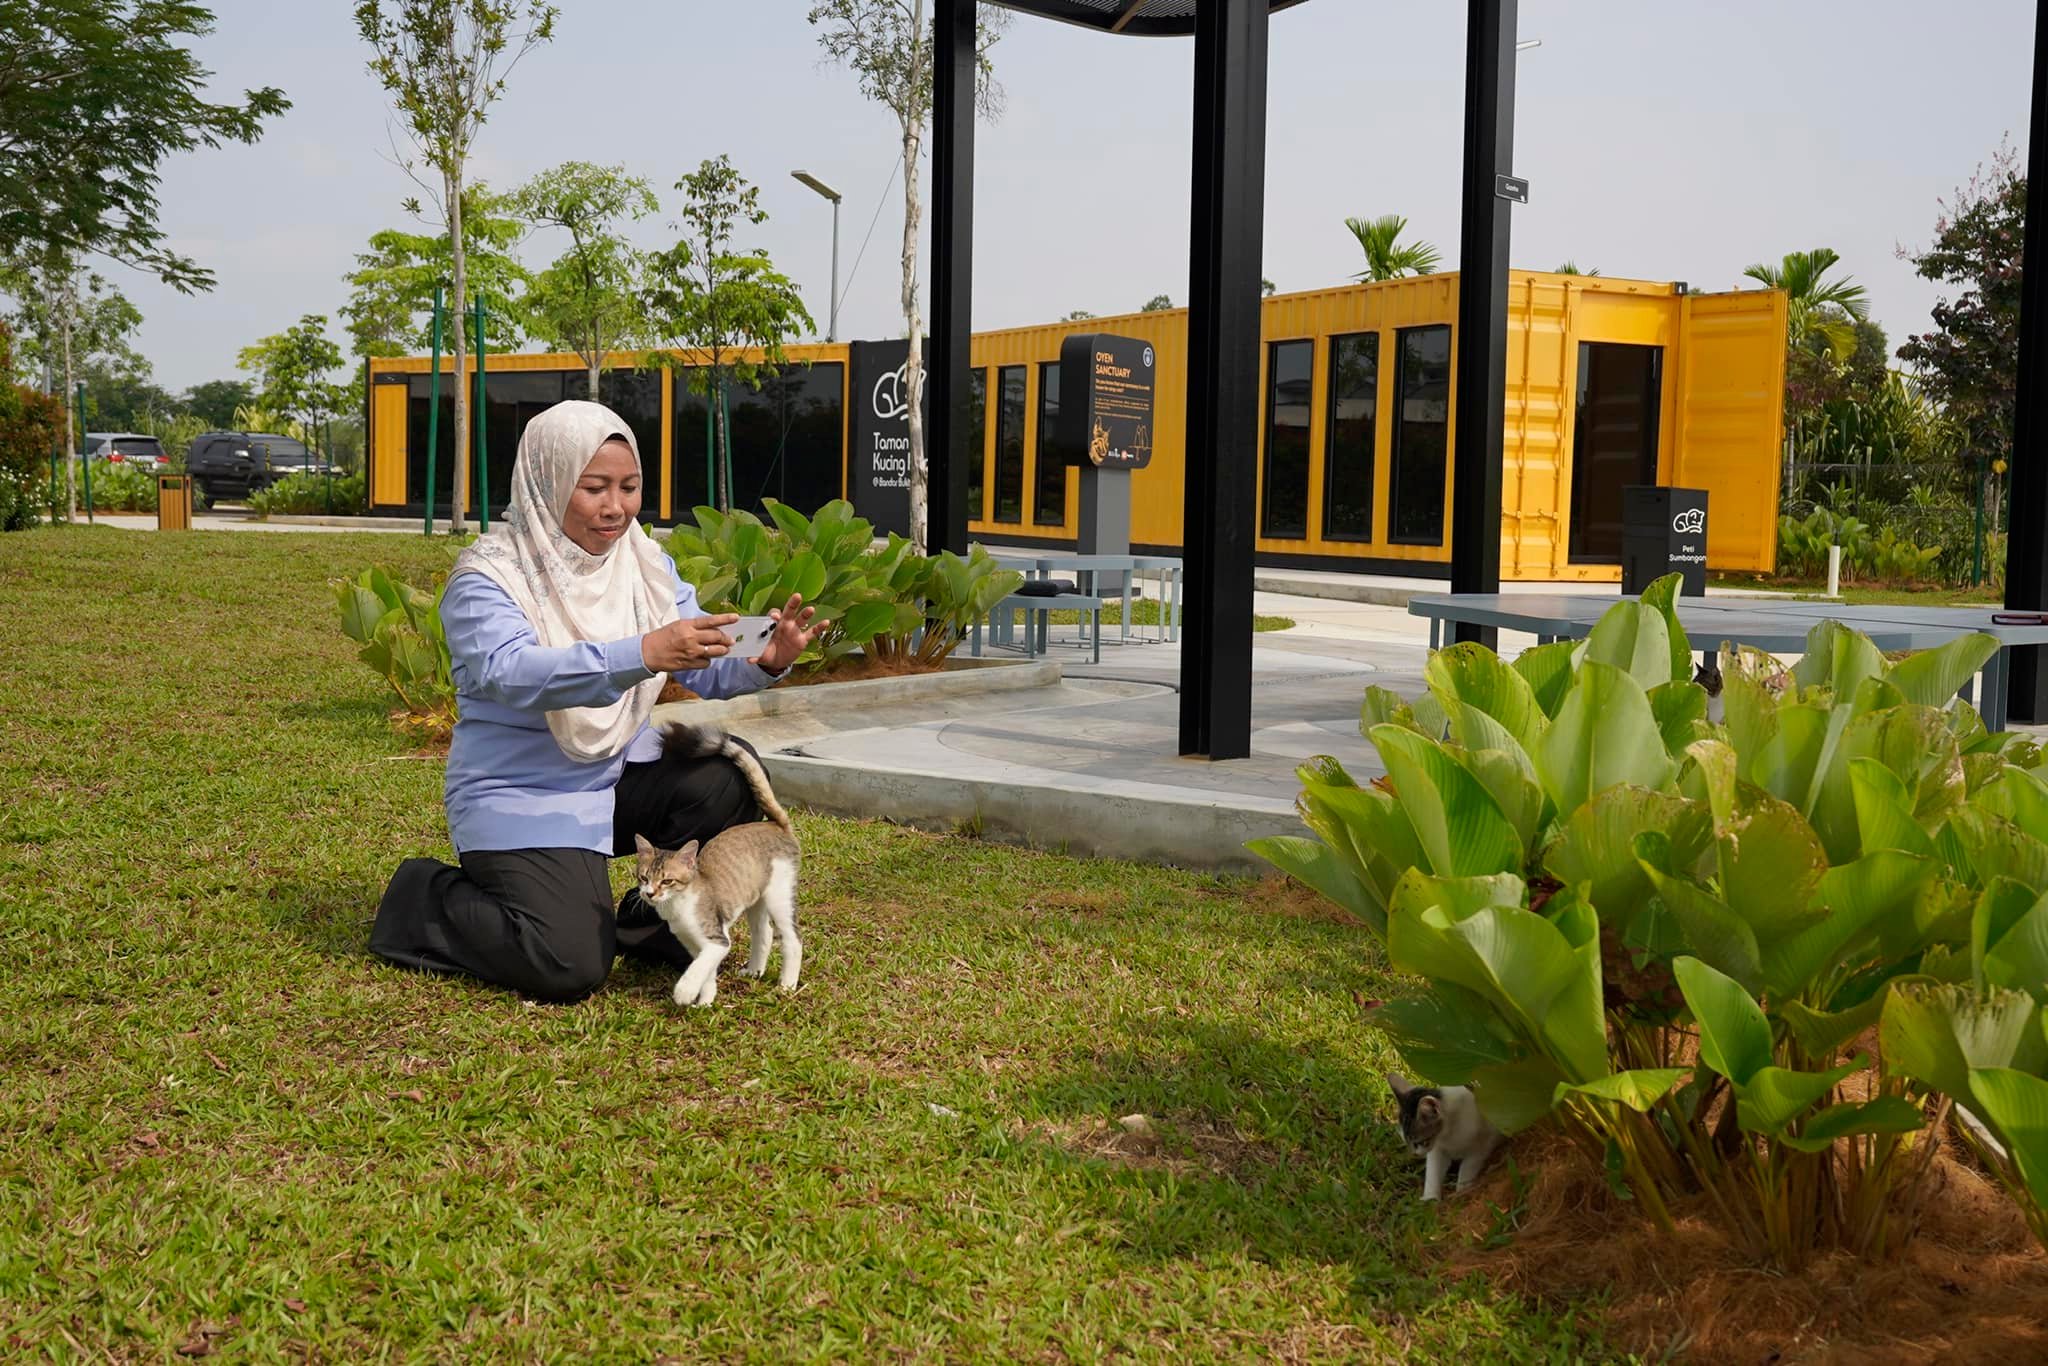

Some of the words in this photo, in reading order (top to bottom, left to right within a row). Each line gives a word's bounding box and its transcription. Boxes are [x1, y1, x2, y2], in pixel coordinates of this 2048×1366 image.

[1096, 351, 1113, 364] OYEN
[1095, 364, 1131, 378] SANCTUARY
[873, 432, 910, 450] Taman
[873, 452, 906, 477] Kucing
[879, 477, 898, 487] Bandar
[1669, 553, 1707, 564] Sumbangan
